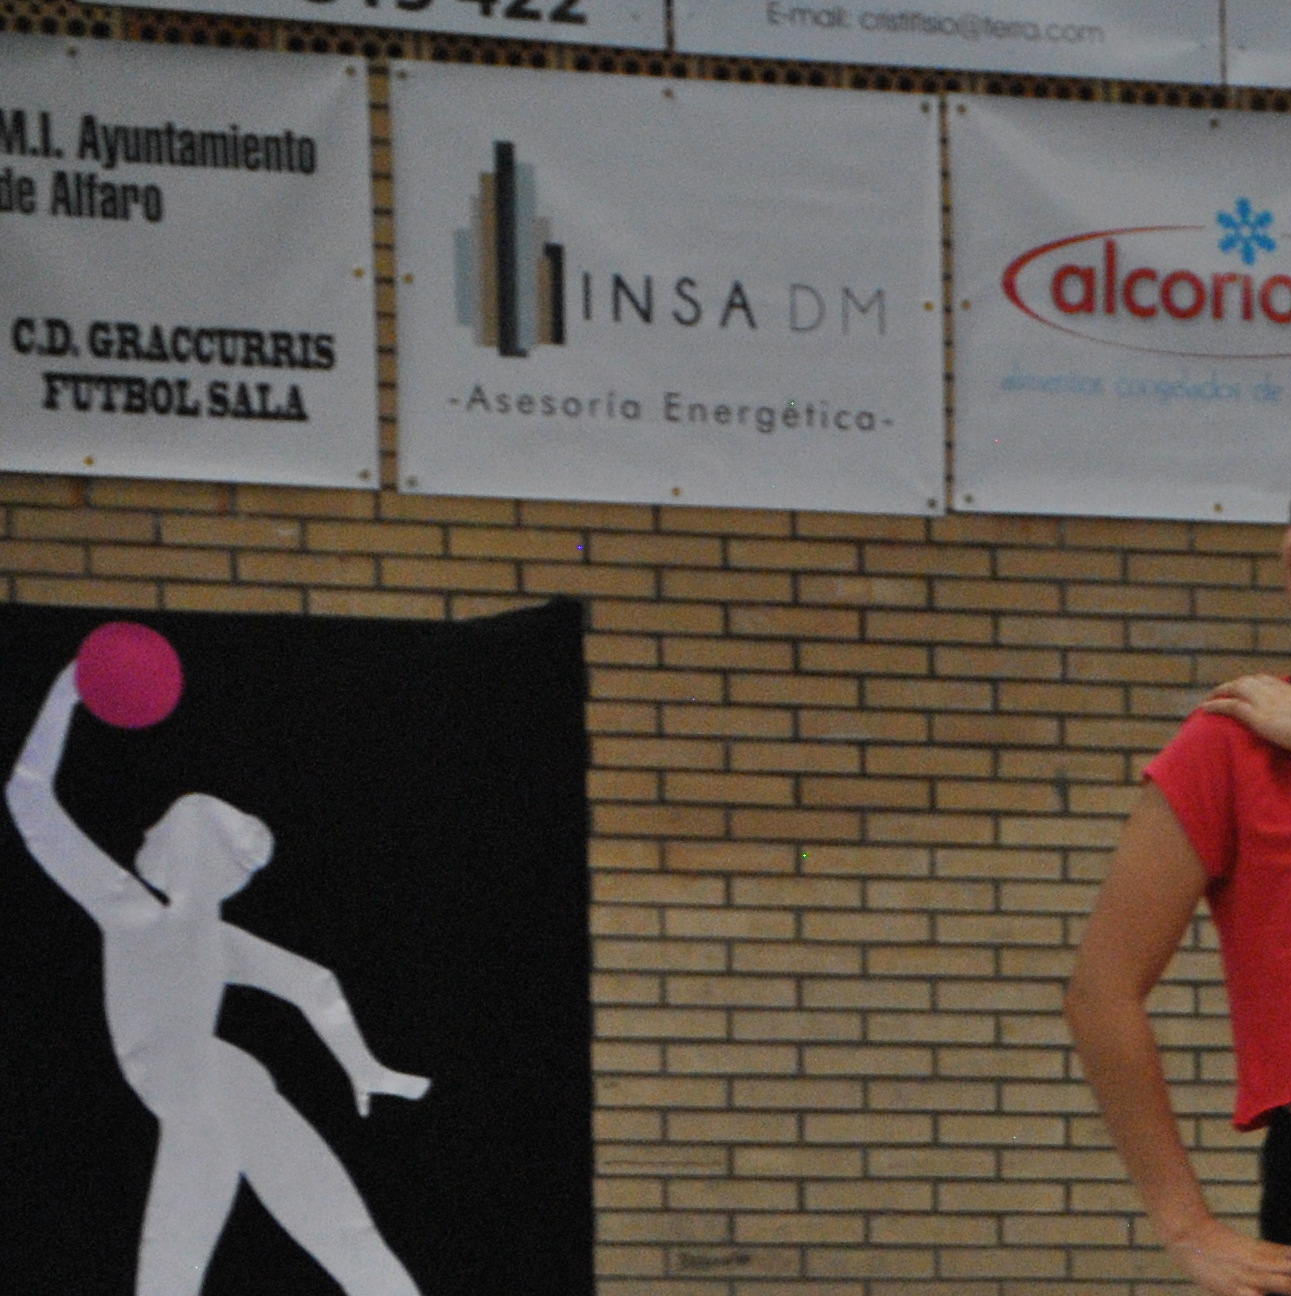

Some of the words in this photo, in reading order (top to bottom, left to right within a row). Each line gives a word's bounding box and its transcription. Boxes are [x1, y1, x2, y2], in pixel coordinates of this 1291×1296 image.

[0, 108, 63, 158] M.I.
[79, 114, 318, 176] Ayuntamiento
[0, 167, 36, 215] de
[50, 170, 163, 223] Alfaro
[583, 272, 756, 329] INSA
[789, 282, 886, 335] DM
[12, 317, 79, 357] C.D.
[87, 321, 335, 370] GRACCURRIS
[43, 371, 200, 417] FUTBOL
[208, 380, 308, 422] SALA
